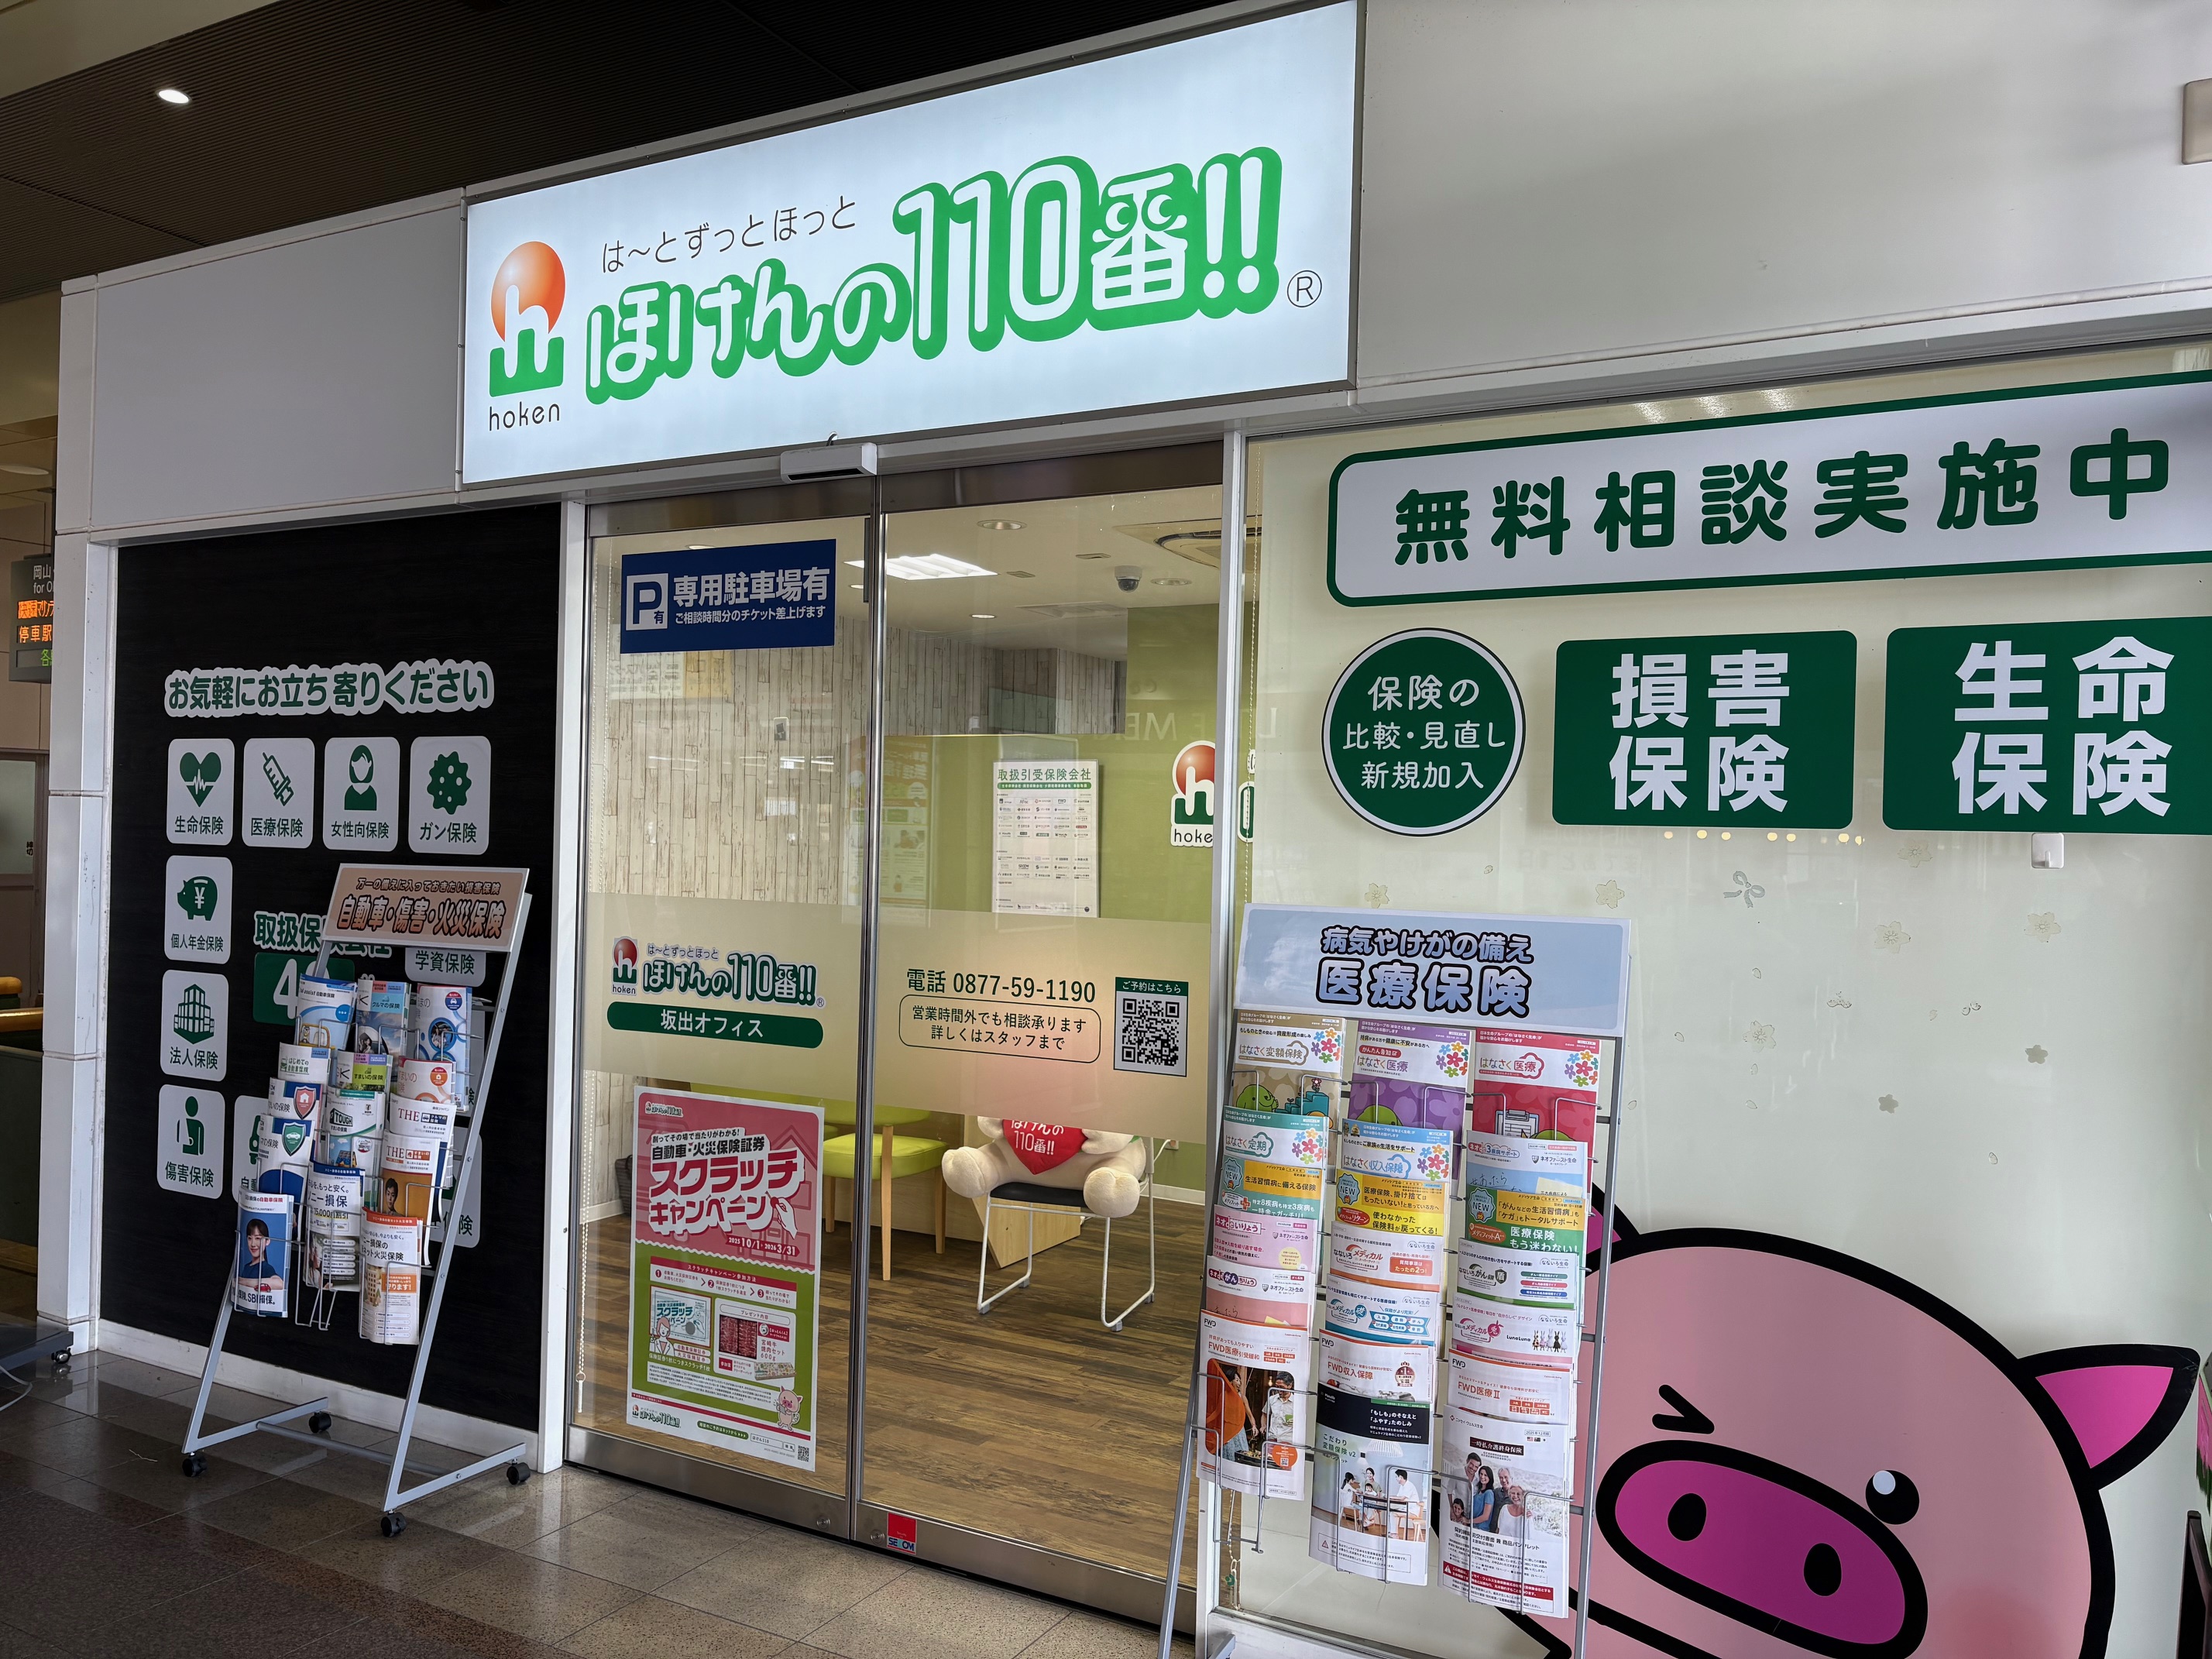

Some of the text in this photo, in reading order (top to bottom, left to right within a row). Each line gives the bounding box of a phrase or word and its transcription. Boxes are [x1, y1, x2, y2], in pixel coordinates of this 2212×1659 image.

[586, 147, 1282, 404] ほけんの110番!!
[488, 403, 561, 432] hoken
[1393, 427, 2172, 566] 無料相談実施中
[33, 582, 45, 594] for
[673, 566, 830, 608] 専用駐車場有
[632, 580, 663, 625] P
[675, 605, 826, 625] ご相談時間分のチケット差上げます
[19, 624, 53, 643] 停車駅
[40, 649, 53, 667] 各
[168, 669, 489, 710] お気軽にお立ち寄りください
[1954, 636, 2176, 725] 生命
[1366, 675, 1480, 712] 保険の
[1610, 650, 1791, 730] 損害
[1342, 718, 1509, 753] 比較・見直し
[998, 768, 1091, 781] 取扱引受保険会社
[1361, 759, 1486, 791] 新規加入
[1609, 733, 1791, 813] 保険
[1951, 730, 2173, 817] 保険
[174, 816, 224, 836] 生命保険
[250, 817, 304, 838] 医療保険
[331, 820, 390, 840] 女性向保険
[419, 821, 477, 844] ガン保険
[356, 878, 501, 895] 万一の備えに入っておきたい損害保険
[337, 895, 506, 939] 自動車・傷害・火災保険
[171, 933, 224, 953] 個人年金保険
[1321, 925, 1534, 965] 病気やけがの備え
[415, 950, 475, 976] 学資保険
[643, 952, 816, 1006] ほけんの110番!!
[906, 968, 1096, 1003] 電話 0877-59-1190
[1121, 980, 1182, 994] ご予約はこちら
[1316, 957, 1533, 1018] 医療保険
[612, 984, 636, 994] hoken
[661, 1008, 764, 1037] 坂出オフィス
[912, 1005, 1087, 1034] 営業時間外でも相談承ります
[931, 1025, 1066, 1051] 詳しくはスタッフまで
[1360, 1035, 1430, 1048] 持病がある方や健康に不安がある方へ
[170, 1046, 218, 1070] 法人保険
[1239, 1043, 1303, 1060] はなさく変額保険
[1357, 1056, 1408, 1073] はなさく医療
[1480, 1057, 1537, 1073] はなさく医療
[354, 1073, 383, 1081] すまいの保険
[398, 1108, 420, 1121] THE
[652, 1129, 740, 1143] 削ってその場で当たりがわかる!
[1013, 1130, 1055, 1156] 110番!!
[1225, 1135, 1266, 1152] はなさく定期
[1344, 1138, 1416, 1152] もしものときにご家族の生活をサポート
[387, 1146, 404, 1159] THE
[652, 1136, 764, 1160] 自動車・火災保険証券
[651, 1149, 798, 1197] スクラッチ
[1344, 1155, 1403, 1173] はなさく収入保障
[165, 1161, 214, 1188] 傷害保険
[1225, 1171, 1238, 1180] NEW
[1245, 1176, 1317, 1191] 生活習慣病に備える保険
[1340, 1185, 1356, 1196] NEW
[1364, 1187, 1427, 1200] 医療保険、掛け捨ては
[650, 1194, 767, 1225] キャンペーン
[1252, 1199, 1314, 1212] 特定8疾病も特定3疾病も
[1364, 1196, 1440, 1211] もったいない!と思っている方へ
[1472, 1202, 1490, 1212] NEW
[1498, 1201, 1580, 1218] 「がんなどの生活習慣病」も
[1372, 1211, 1416, 1224] 使わなかった
[1498, 1211, 1578, 1226] 「ケガ」もトータルサポート
[1372, 1221, 1437, 1235] 保険料が戻ってくる!
[1510, 1226, 1555, 1242] 医療保険
[1510, 1238, 1578, 1253] もう迷わない!
[688, 1265, 757, 1283] スクラッチキャンペーン参加方法
[657, 1307, 693, 1317] スクラッチ
[740, 1310, 768, 1321] プレゼント内容
[1204, 1318, 1217, 1328] FWD
[678, 1345, 706, 1355] 自動車保険証券
[761, 1346, 785, 1355] 焼肉セット
[1208, 1341, 1260, 1360] FWD医療引受緩和
[1322, 1338, 1334, 1347] FWD
[649, 1353, 710, 1372] 保険証券1枚につきスクラッチ1枚
[678, 1352, 706, 1362] 火災保険証券
[1452, 1358, 1466, 1368] FWD
[1328, 1361, 1374, 1380] FWD収入保障
[1370, 1409, 1417, 1420] 「もしも」のそなえと
[1370, 1417, 1412, 1427] 「ふやす」たのしみ
[1322, 1441, 1348, 1456] 変額保険
[1323, 1434, 1347, 1446] こだわり
